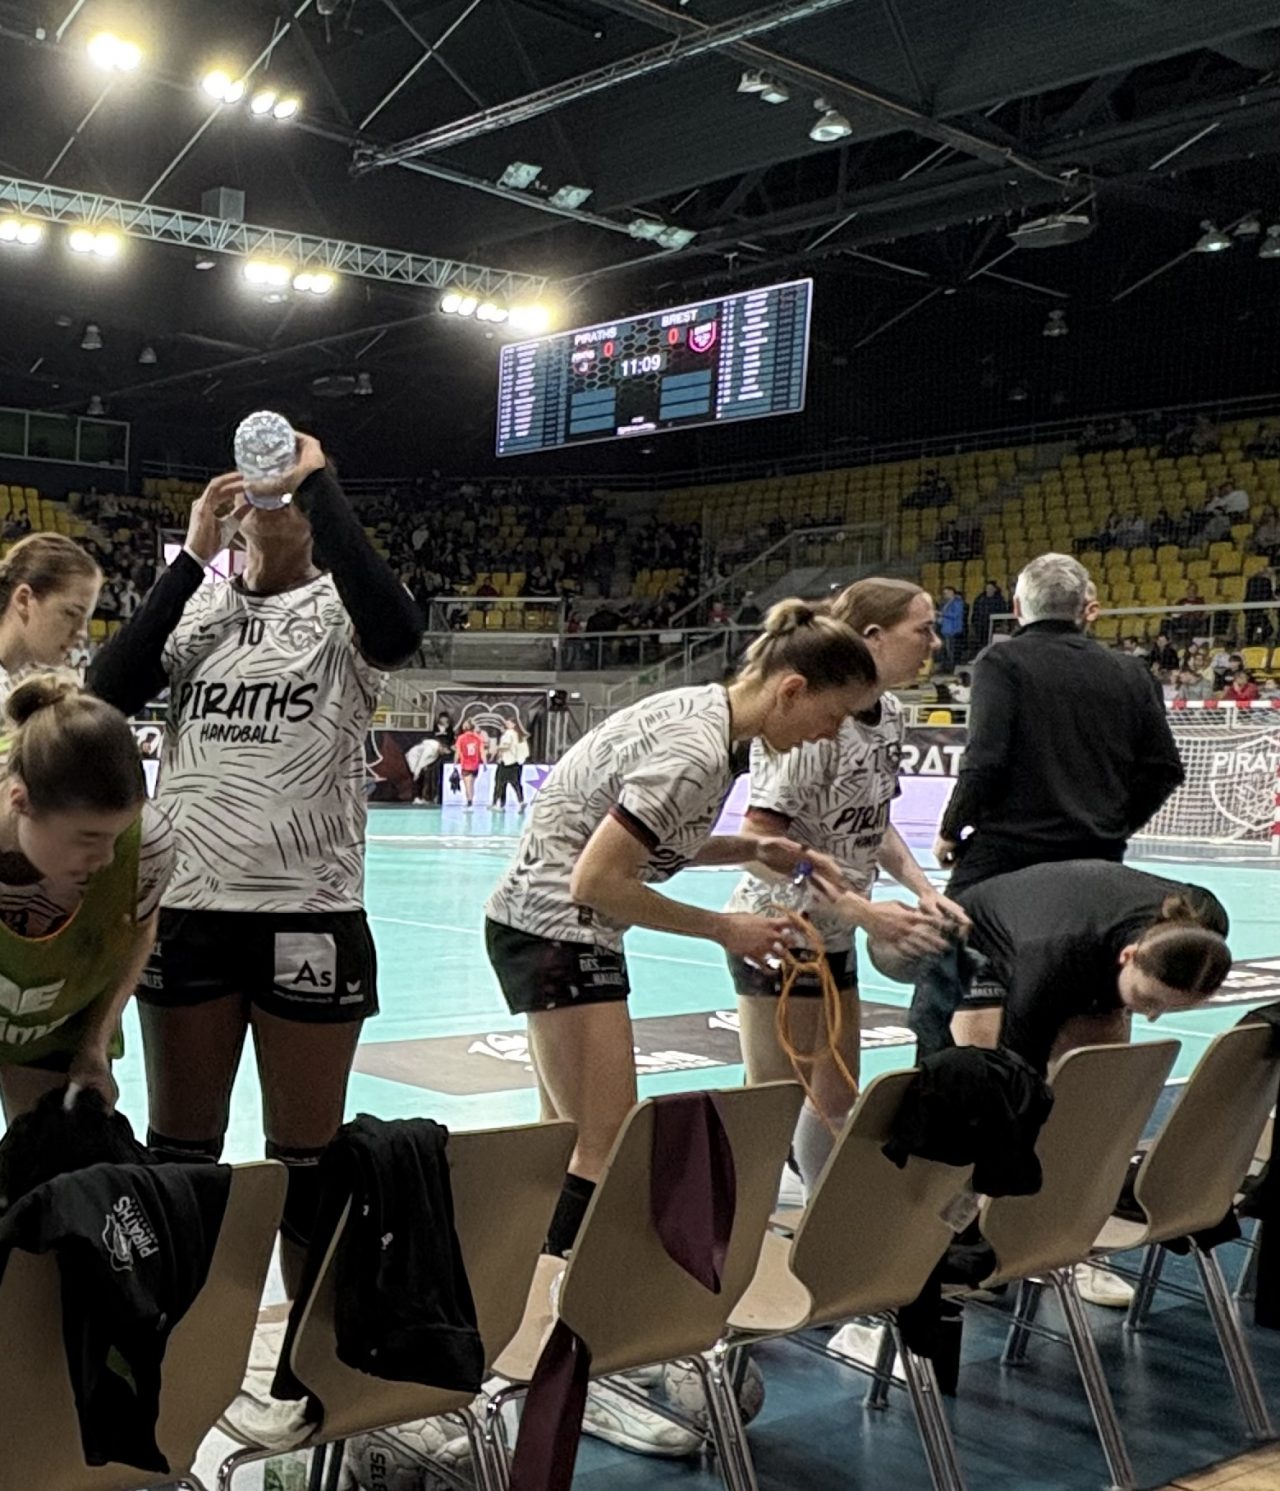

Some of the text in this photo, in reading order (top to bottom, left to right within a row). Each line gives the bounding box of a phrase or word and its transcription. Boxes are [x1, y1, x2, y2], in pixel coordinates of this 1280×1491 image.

[661, 309, 699, 327] BREST
[574, 327, 618, 346] PIRATHS
[668, 327, 679, 344] 0
[603, 341, 614, 358] 0
[621, 354, 662, 377] 11:09
[238, 617, 265, 647] 10
[178, 680, 319, 723] PIRATHS
[199, 722, 283, 744] HANDBALL
[291, 960, 334, 988] As
[113, 1196, 160, 1259] PIRATHS
